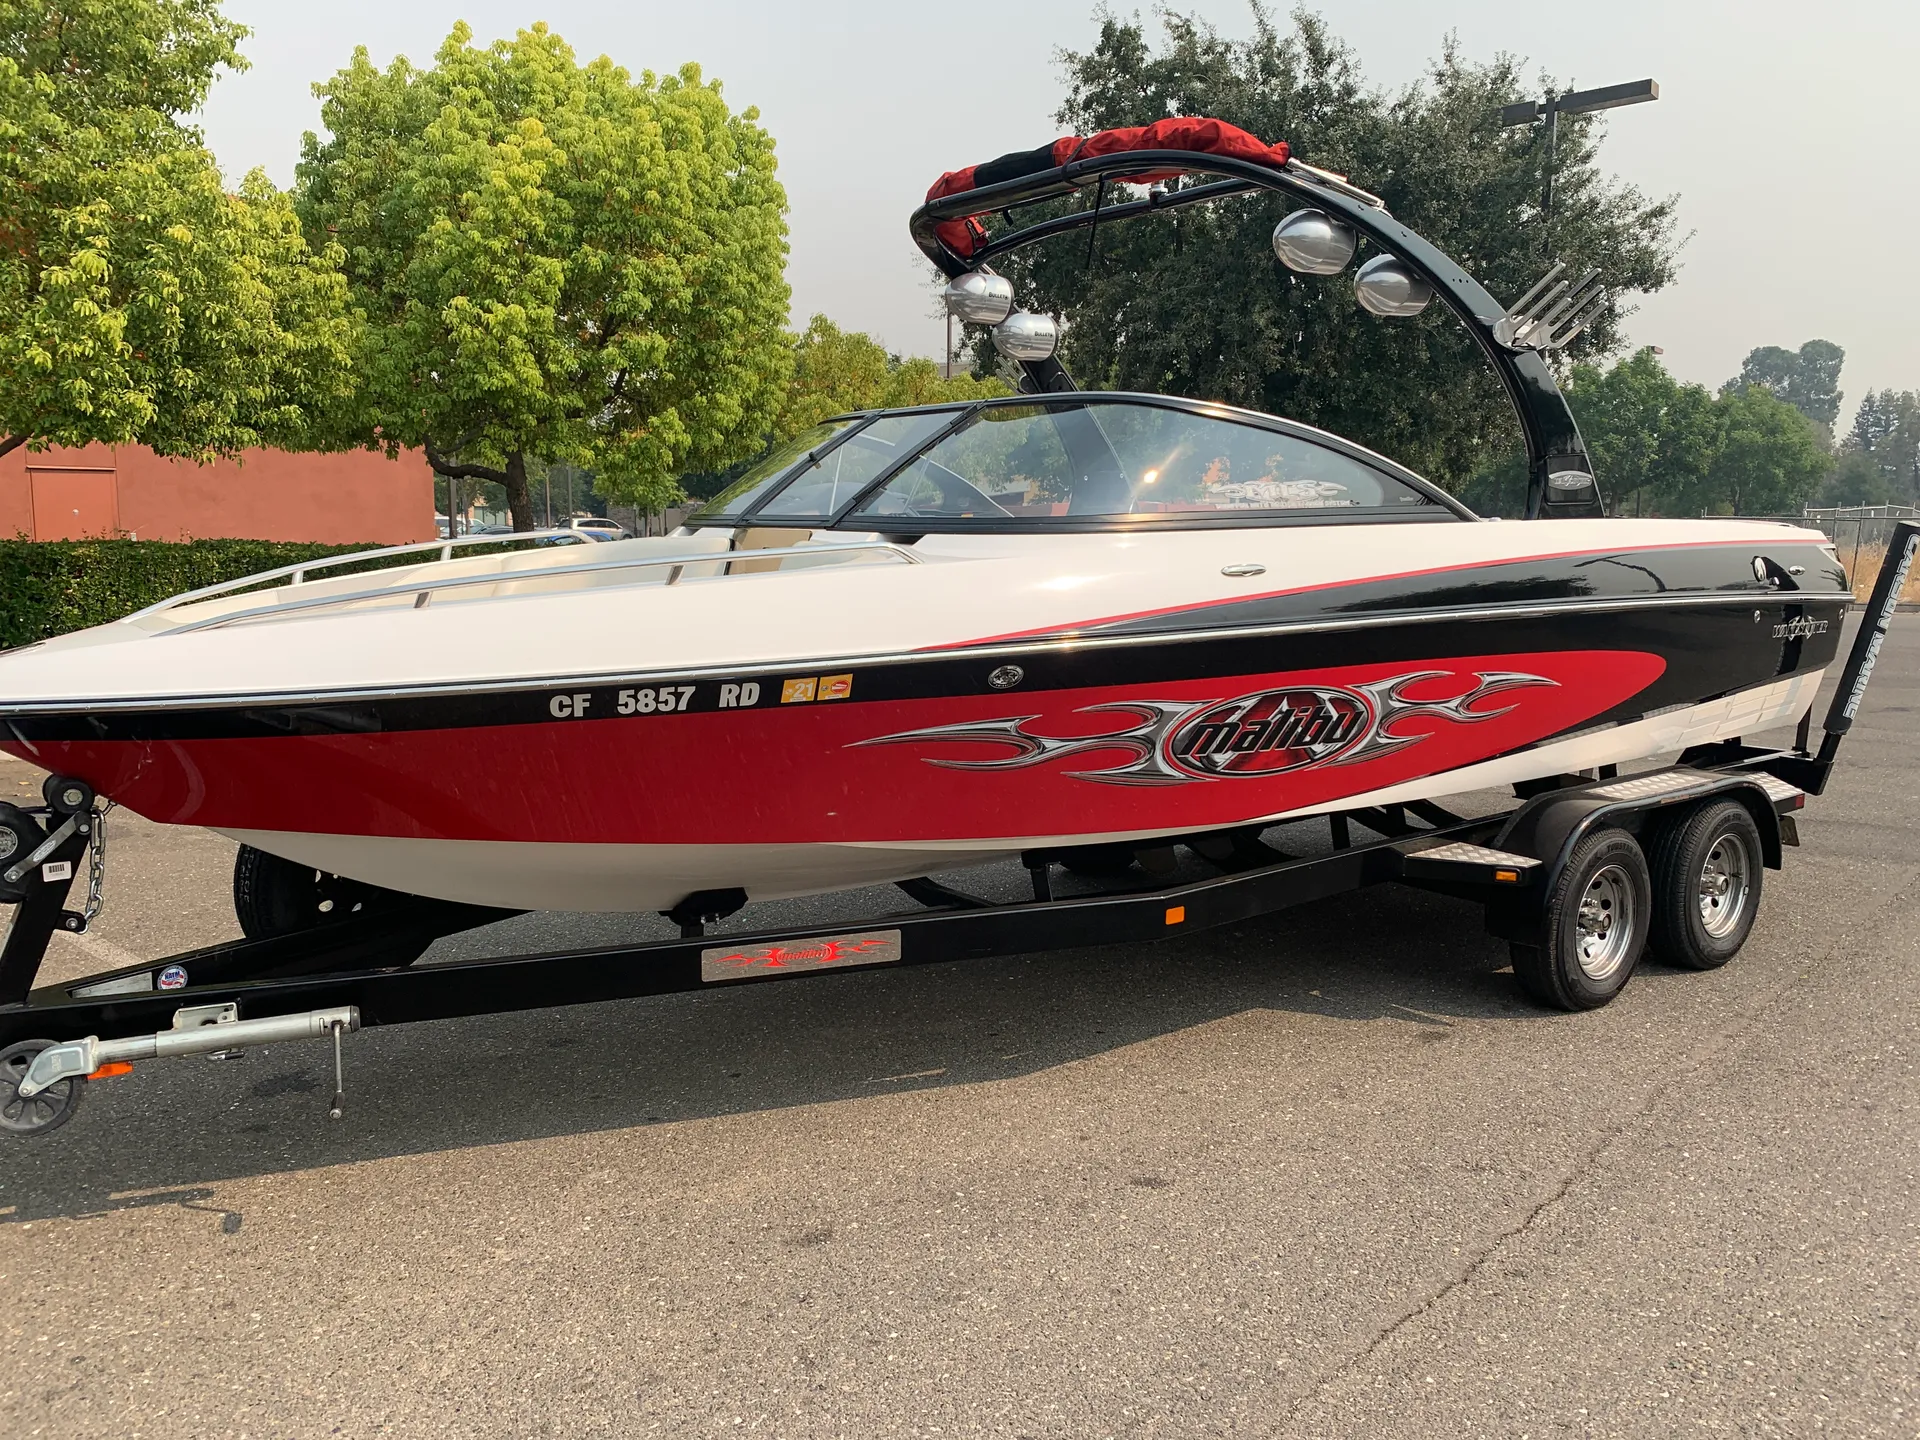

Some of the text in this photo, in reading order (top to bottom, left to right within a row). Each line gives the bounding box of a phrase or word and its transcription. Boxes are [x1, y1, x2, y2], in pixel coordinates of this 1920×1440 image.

[1842, 533, 1920, 720] CARSON MARINE
[550, 681, 761, 718] CF 5857 RD
[793, 682, 814, 698] 21
